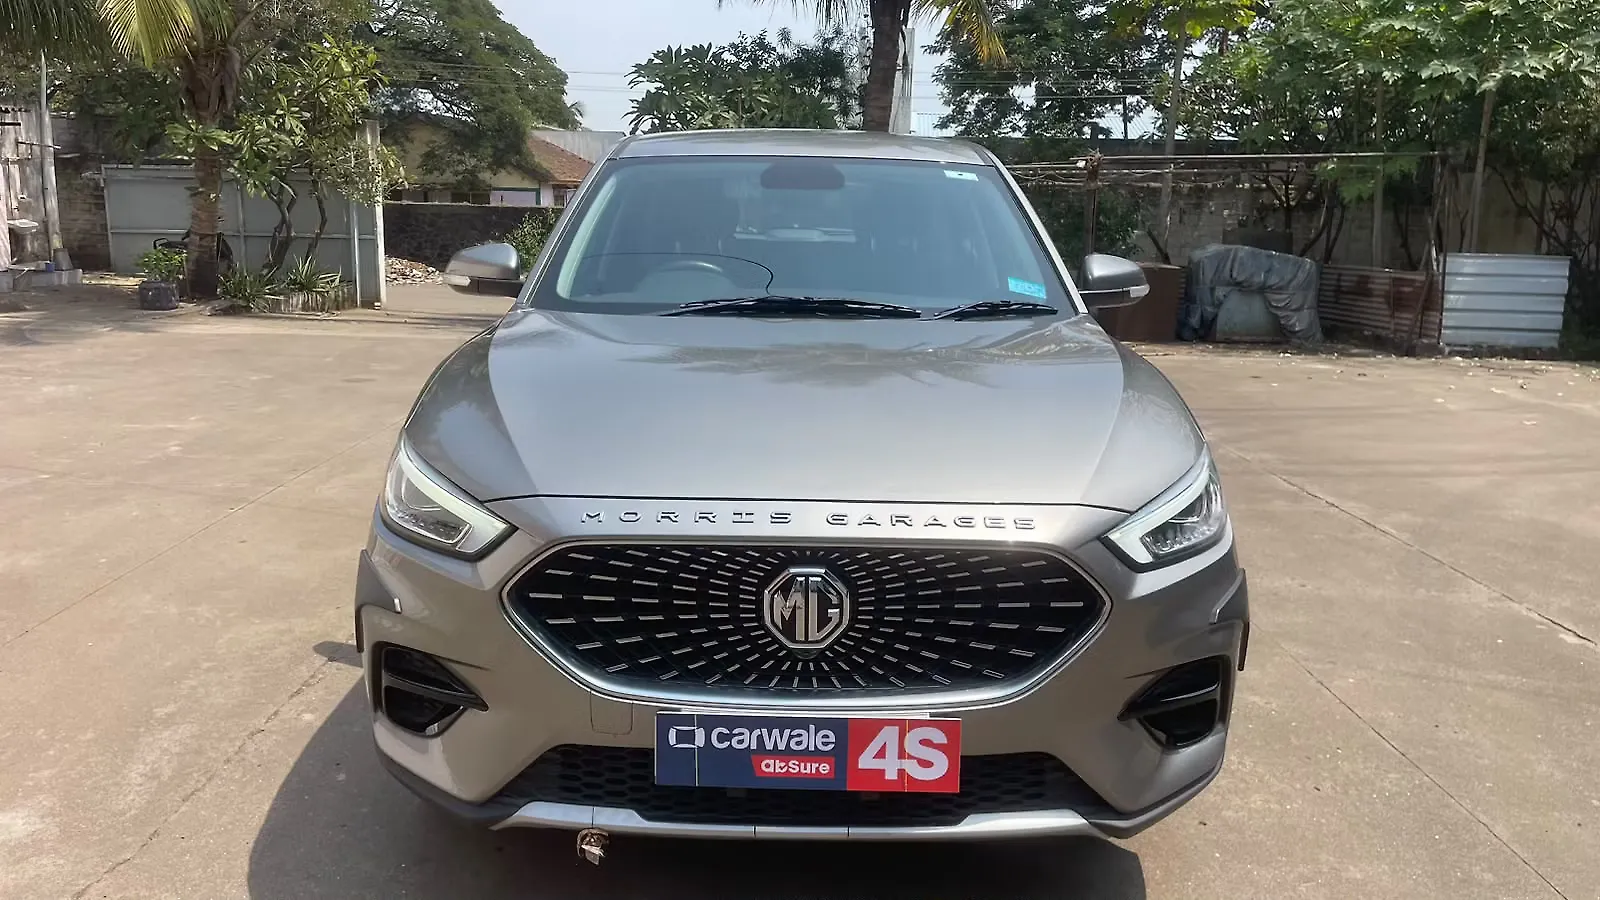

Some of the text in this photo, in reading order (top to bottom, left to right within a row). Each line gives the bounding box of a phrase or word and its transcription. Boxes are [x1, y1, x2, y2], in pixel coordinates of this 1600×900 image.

[581, 511, 1036, 530] MORRIS GARAGES
[774, 576, 840, 641] MG
[710, 724, 836, 751] carwale
[858, 726, 949, 780] 4S
